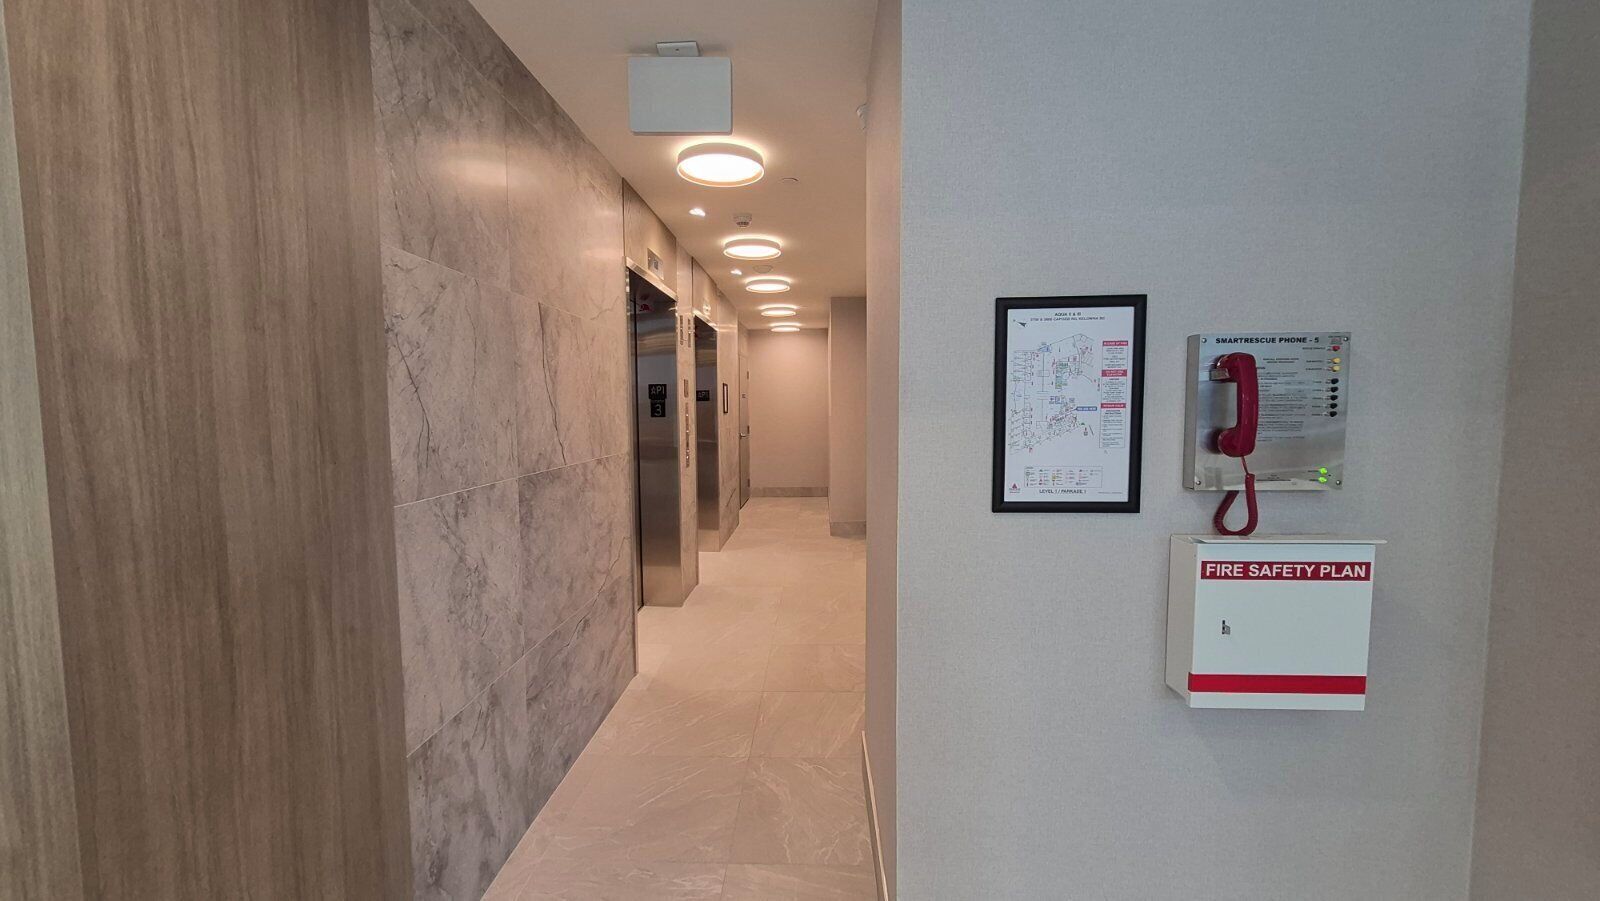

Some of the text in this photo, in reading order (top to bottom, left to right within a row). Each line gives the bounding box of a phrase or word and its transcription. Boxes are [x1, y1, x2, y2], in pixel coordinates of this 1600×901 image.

[1215, 336, 1277, 344] SMARTRESCUE
[1279, 336, 1307, 344] PHONE
[654, 404, 662, 416] 3
[1205, 563, 1366, 578] FIRE SAFETY PLAN
